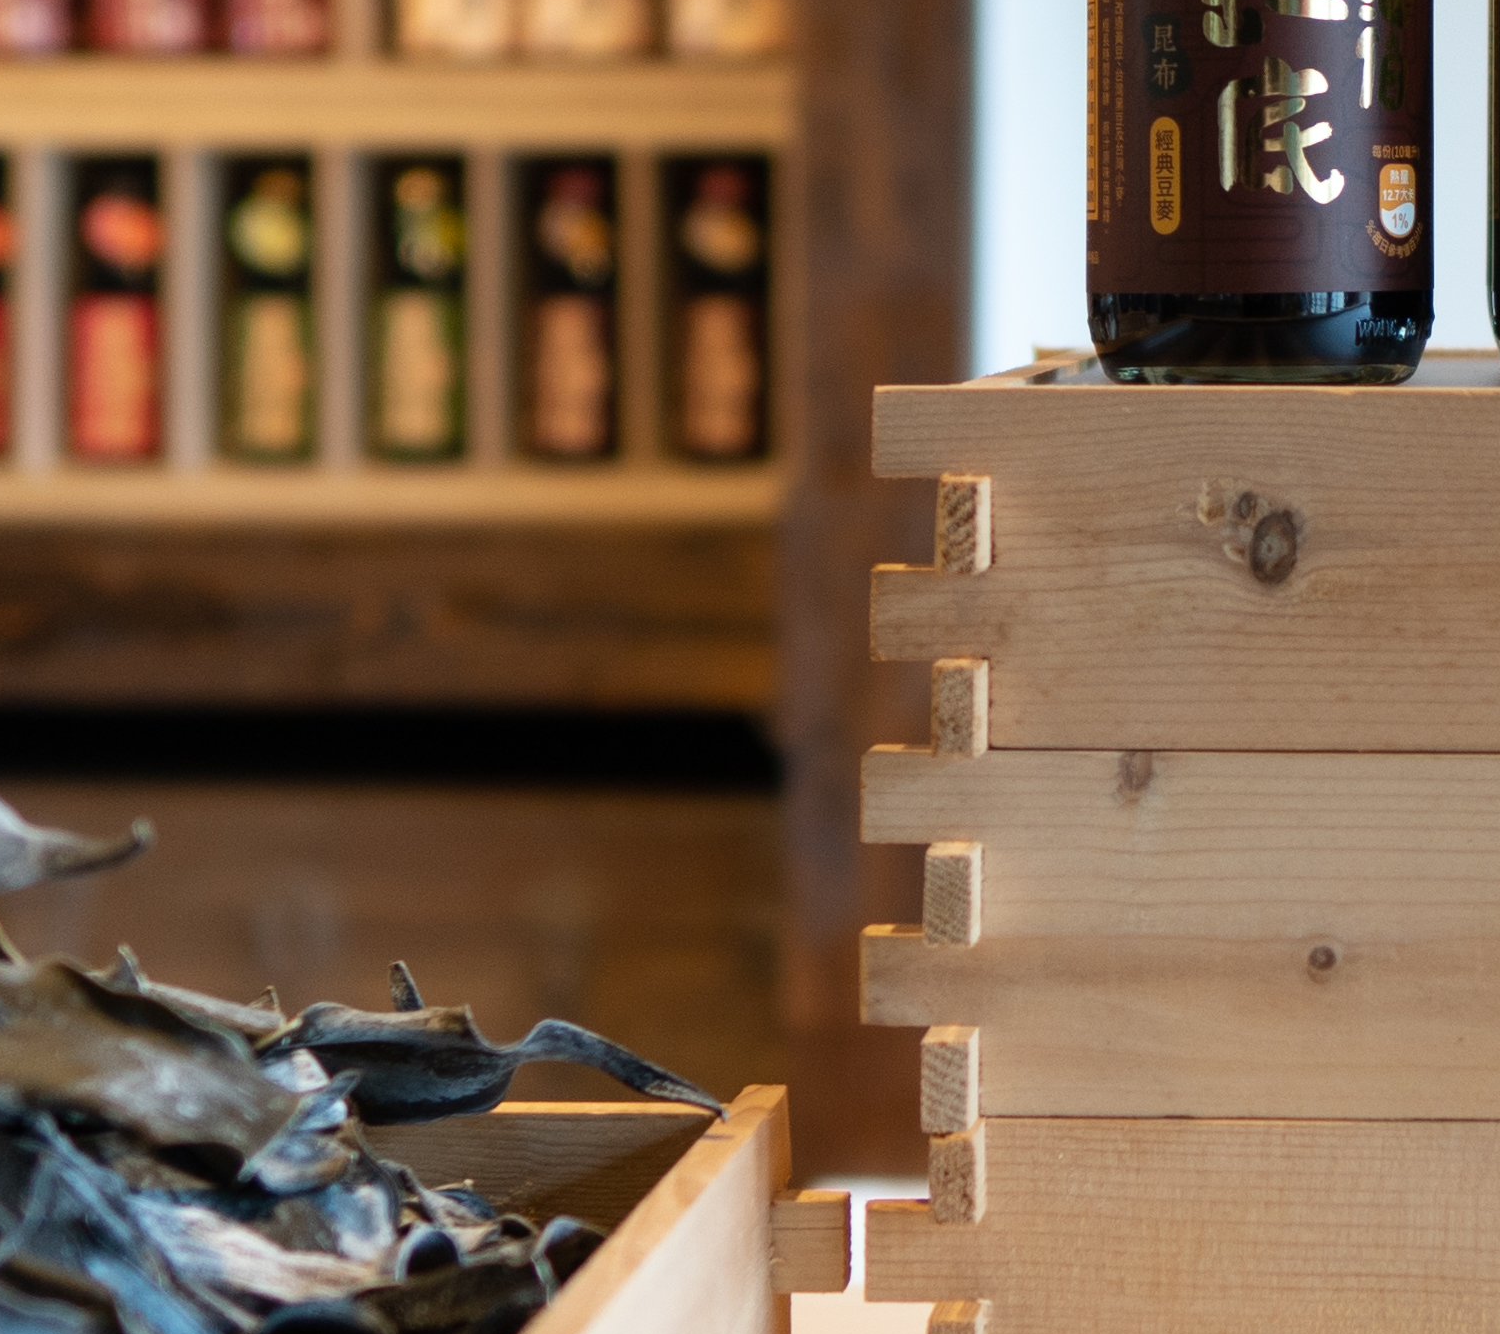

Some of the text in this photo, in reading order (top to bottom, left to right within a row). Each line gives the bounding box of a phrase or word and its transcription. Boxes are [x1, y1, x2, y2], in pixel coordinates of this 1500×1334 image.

[1151, 24, 1179, 91] 昆布
[1154, 129, 1176, 222] 經典豆麥
[1392, 213, 1408, 229] 1%
